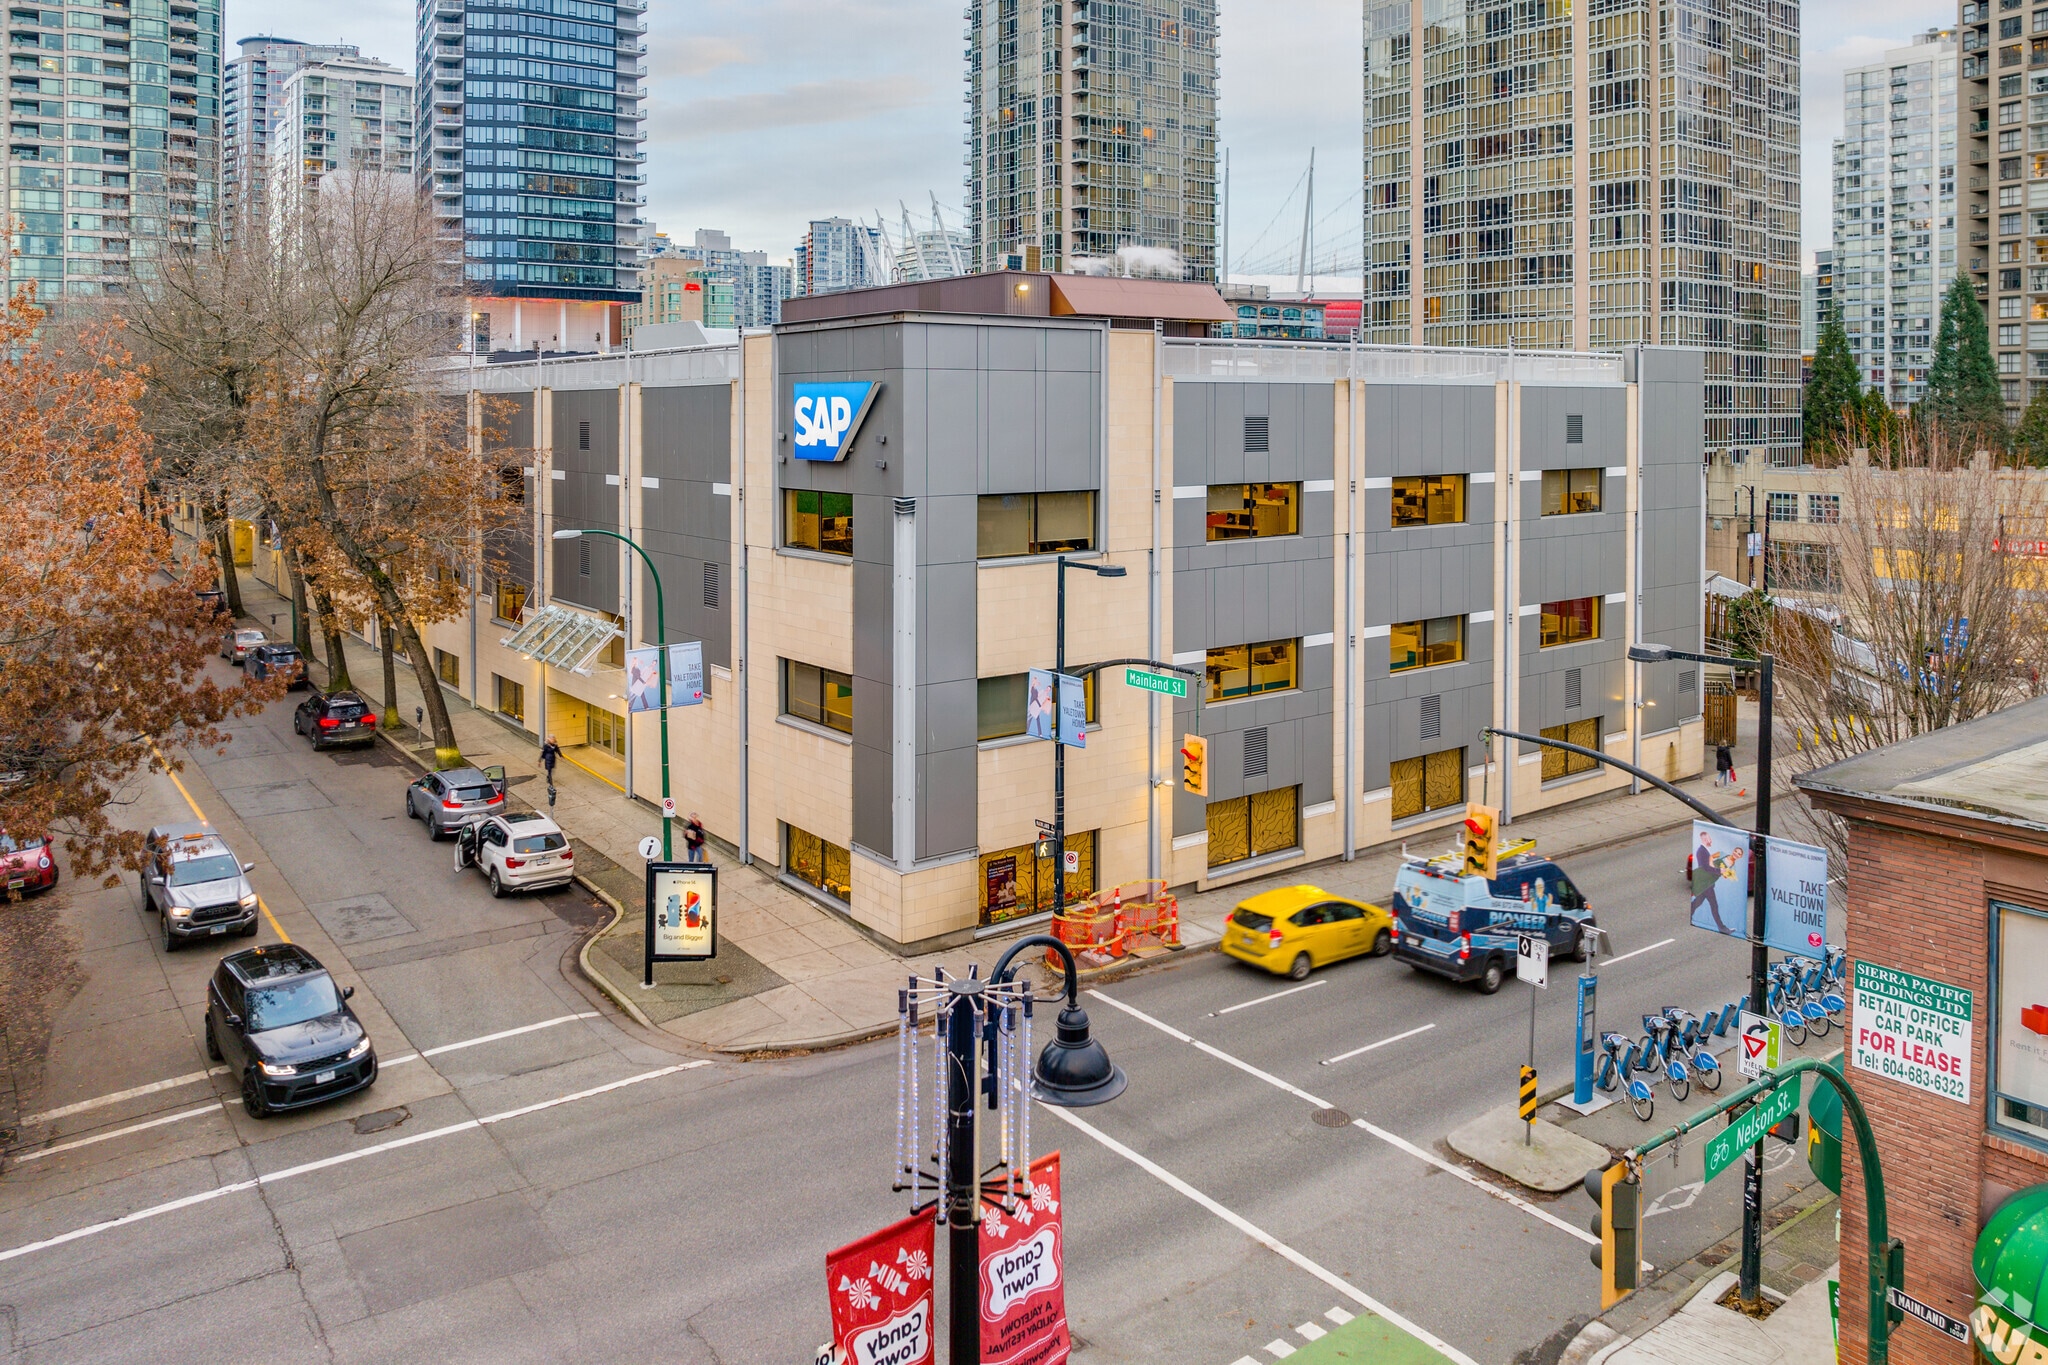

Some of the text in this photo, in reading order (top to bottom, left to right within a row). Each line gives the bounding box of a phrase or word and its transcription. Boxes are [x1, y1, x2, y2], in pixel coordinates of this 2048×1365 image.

[794, 396, 852, 447] SAP
[673, 671, 702, 682] YALETOWN
[688, 663, 701, 671] TAKE
[686, 680, 702, 689] HOME
[1130, 672, 1182, 694] Mainland St
[1063, 706, 1085, 719] YALETOWN
[1074, 699, 1085, 710] TAKE
[1072, 719, 1085, 729] HOME
[1800, 879, 1824, 897] TAKE
[1771, 887, 1824, 912] YALETOWN
[1489, 911, 1547, 930] PIONEER
[1794, 909, 1823, 928] HOME
[1857, 963, 1970, 1004] SIERRA PACIFIC
[1859, 977, 1968, 1018] HOLDINGS LTD.
[1858, 992, 1965, 1038] RETAIL/OFFICE/
[1875, 1014, 1943, 1048] CAR PARK
[1860, 1027, 1962, 1077] FOR LEASE
[2010, 1039, 2031, 1052] Rent
[2033, 1046, 2040, 1055] it
[1744, 1060, 1763, 1071] YIELD
[1857, 1048, 1879, 1070] Tel:
[1736, 1090, 1801, 1151] Nelson St.
[1898, 1294, 1962, 1331] MAINLAND ST
[1949, 1327, 1964, 1340] 1000
